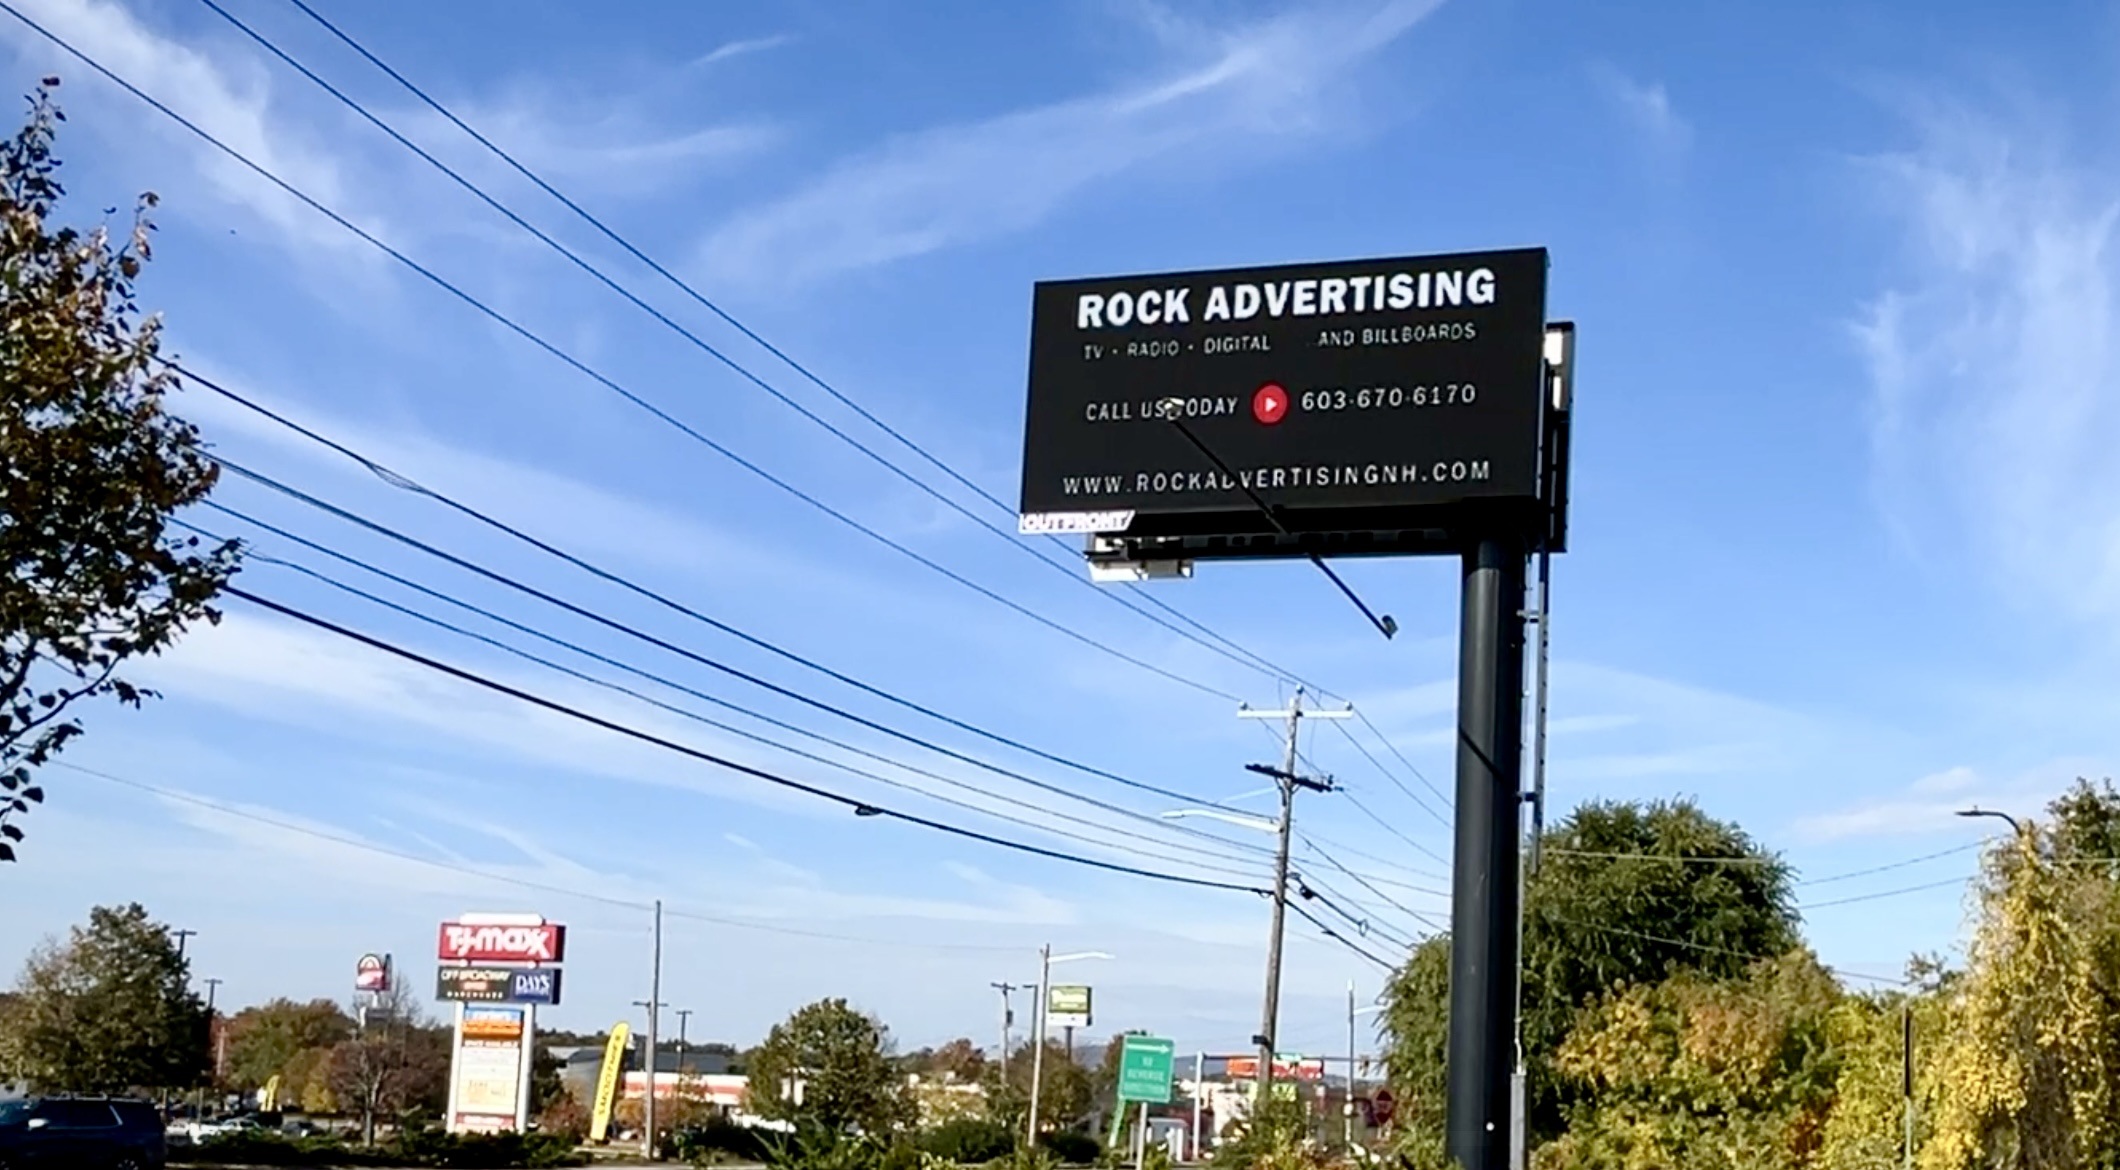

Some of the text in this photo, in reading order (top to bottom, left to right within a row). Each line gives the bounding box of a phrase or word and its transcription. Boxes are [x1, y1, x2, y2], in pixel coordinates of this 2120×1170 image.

[1077, 267, 1496, 330] ROCK ADVERTISING
[1084, 321, 1477, 360] TV RADIO DIGITAL AND BILLBOARDS
[1086, 402, 1132, 421] CALL
[1141, 399, 1165, 418] US
[1173, 397, 1239, 418] ODAY
